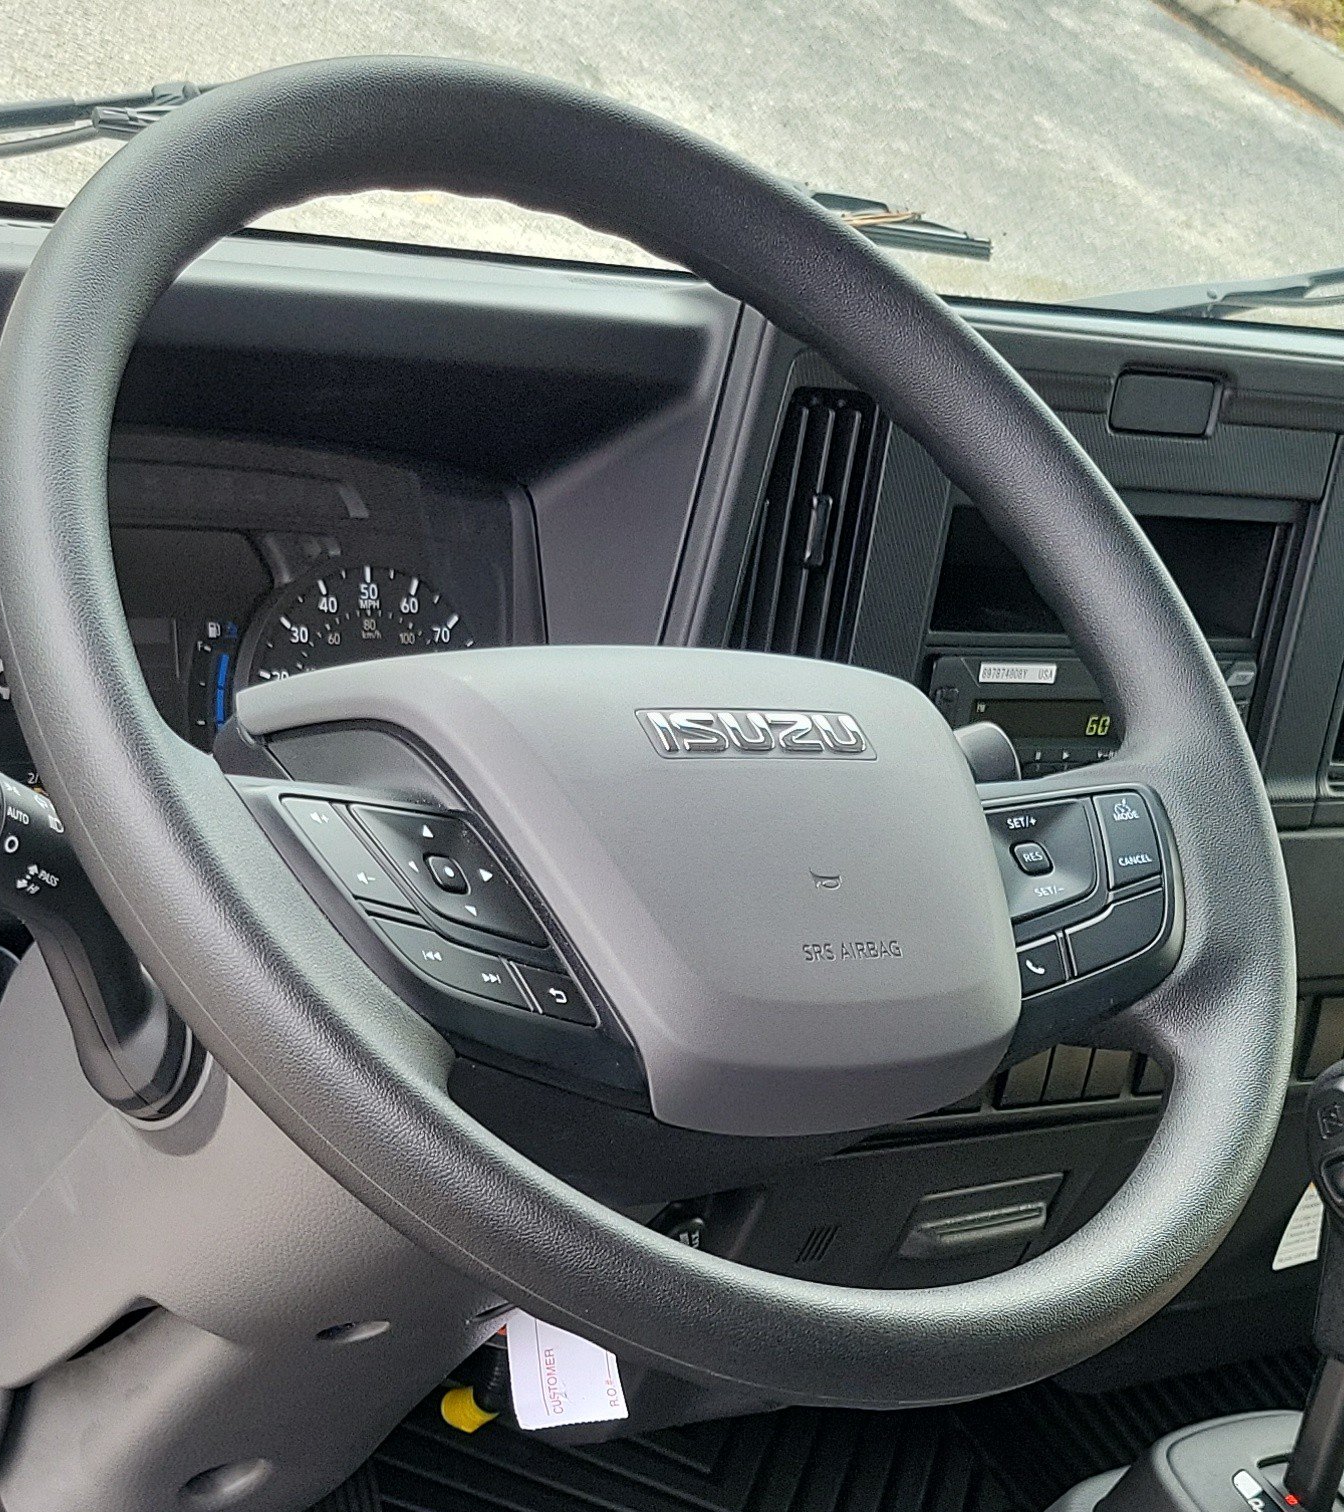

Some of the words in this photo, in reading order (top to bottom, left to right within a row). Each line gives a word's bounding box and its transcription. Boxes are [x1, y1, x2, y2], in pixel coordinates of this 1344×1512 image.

[359, 583, 378, 600] 50
[318, 596, 338, 613] 40
[359, 600, 380, 610] MPH
[400, 597, 419, 613] 60
[363, 619, 376, 630] 80
[290, 626, 308, 644] 30
[327, 633, 341, 645] 60
[399, 633, 416, 645] 100
[433, 627, 451, 643] 70
[1038, 668, 1053, 680] USA
[647, 712, 867, 752] ISUZU
[7, 806, 30, 825] AUTO
[1007, 816, 1037, 829] SET/+
[1113, 810, 1139, 821] MODE
[1023, 852, 1043, 863] RES
[1118, 853, 1152, 867] CANCEL
[802, 943, 836, 962] SRS
[841, 940, 903, 960] AIRBAG
[545, 1348, 564, 1414] CUSTOMER
